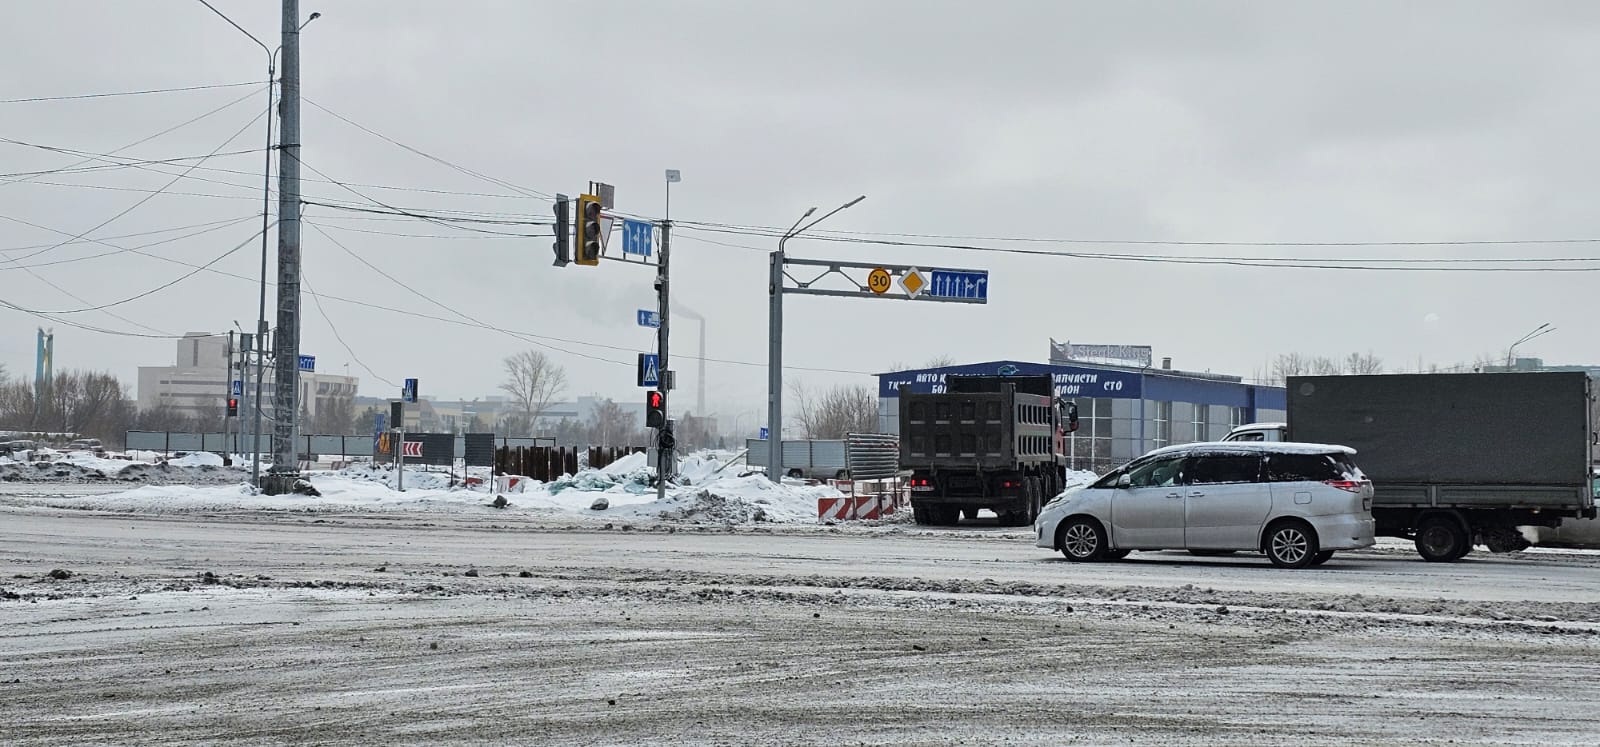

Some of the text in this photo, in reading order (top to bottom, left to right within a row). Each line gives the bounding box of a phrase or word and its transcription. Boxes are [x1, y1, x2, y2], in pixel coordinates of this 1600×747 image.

[872, 275, 887, 287] 30
[916, 373, 937, 383] АВТО
[1103, 381, 1123, 391] СТО
